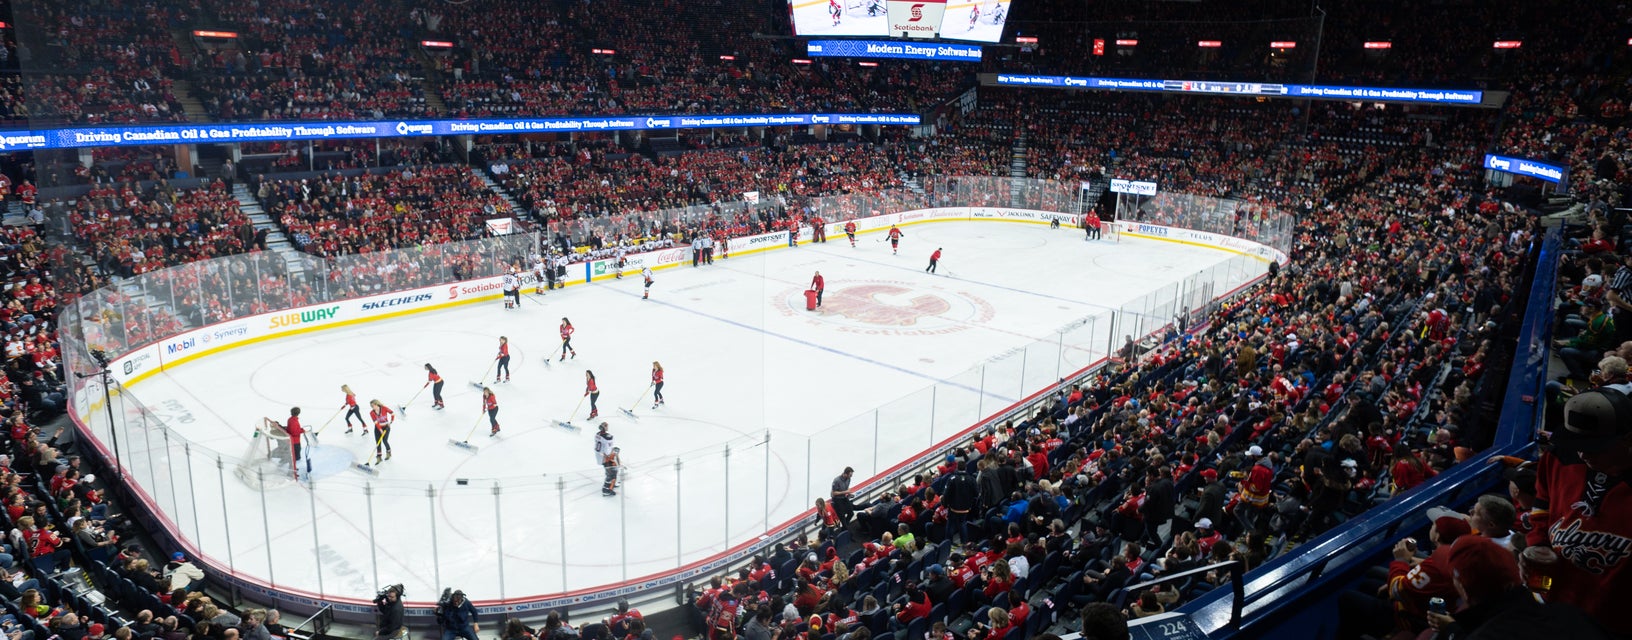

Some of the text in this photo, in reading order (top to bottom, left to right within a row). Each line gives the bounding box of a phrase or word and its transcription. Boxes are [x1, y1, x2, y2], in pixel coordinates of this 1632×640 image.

[894, 24, 934, 32] Scotiabank
[867, 43, 903, 54] Modern
[905, 45, 937, 57] Energy
[938, 46, 967, 57] Software
[1300, 87, 1323, 96] Driving
[1323, 88, 1352, 96] Canadian
[451, 119, 634, 132] Driving Canadian Oil & Gas Profitability Through Software
[681, 118, 701, 127] Driving
[76, 125, 376, 143] Driving Canadian Oil & Gas Profitability Through Software
[1040, 213, 1072, 223] SAFEWAY
[749, 232, 787, 245] SPORTSNET
[361, 293, 433, 311] SKECHERS
[269, 306, 340, 329] SUBWAY
[214, 326, 248, 340] Synergy
[167, 338, 195, 355] Mobil
[1548, 516, 1632, 566] Calgary
[659, 576, 676, 585] KEEPING
[681, 571, 694, 580] FRESH
[598, 591, 616, 599] KEEPING
[622, 586, 637, 595] FRESH
[490, 606, 506, 614] FRESH
[532, 601, 551, 609] KEEPING
[558, 598, 573, 606] FRESH
[1158, 621, 1187, 637] 224
